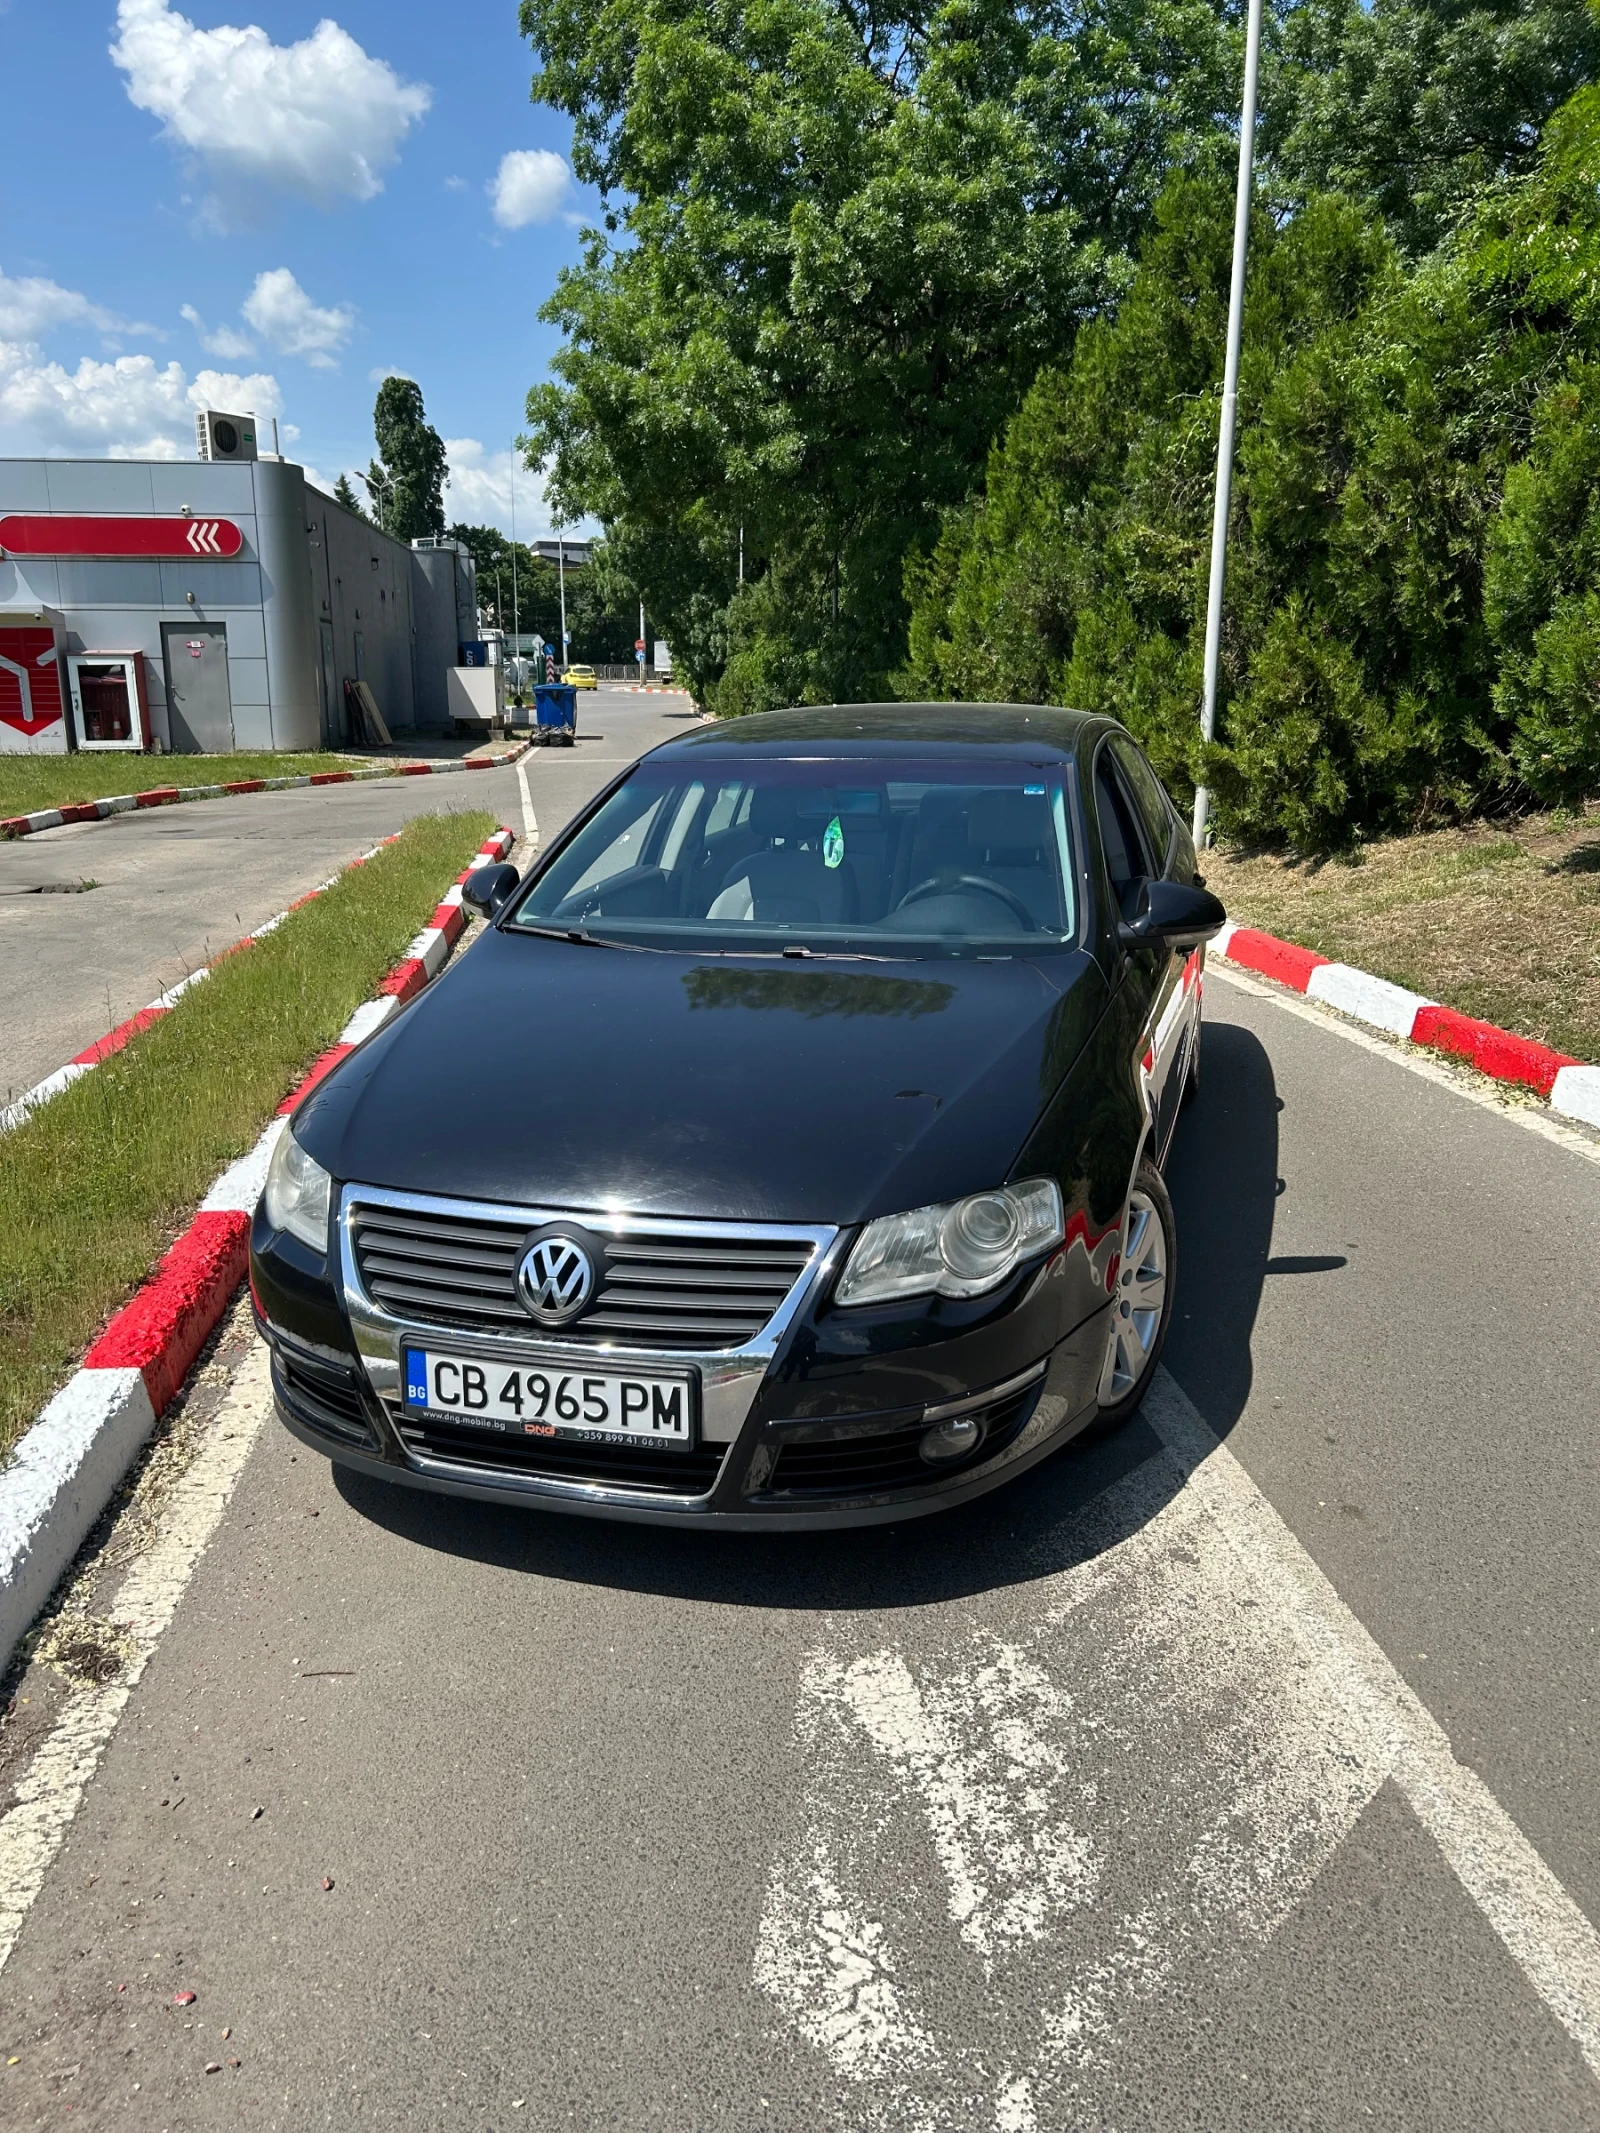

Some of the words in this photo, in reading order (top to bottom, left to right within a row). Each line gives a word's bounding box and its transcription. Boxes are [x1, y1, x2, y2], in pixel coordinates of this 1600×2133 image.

[408, 1384, 426, 1400] BG
[434, 1360, 489, 1409] CB
[499, 1370, 609, 1423] 4965
[620, 1381, 682, 1432] PM
[422, 1410, 506, 1431] www.dng.mobile.bg
[524, 1423, 556, 1435] DNG
[577, 1431, 602, 1440] +359
[605, 1433, 623, 1442] 899
[626, 1435, 638, 1444] 41
[641, 1437, 654, 1447] 06
